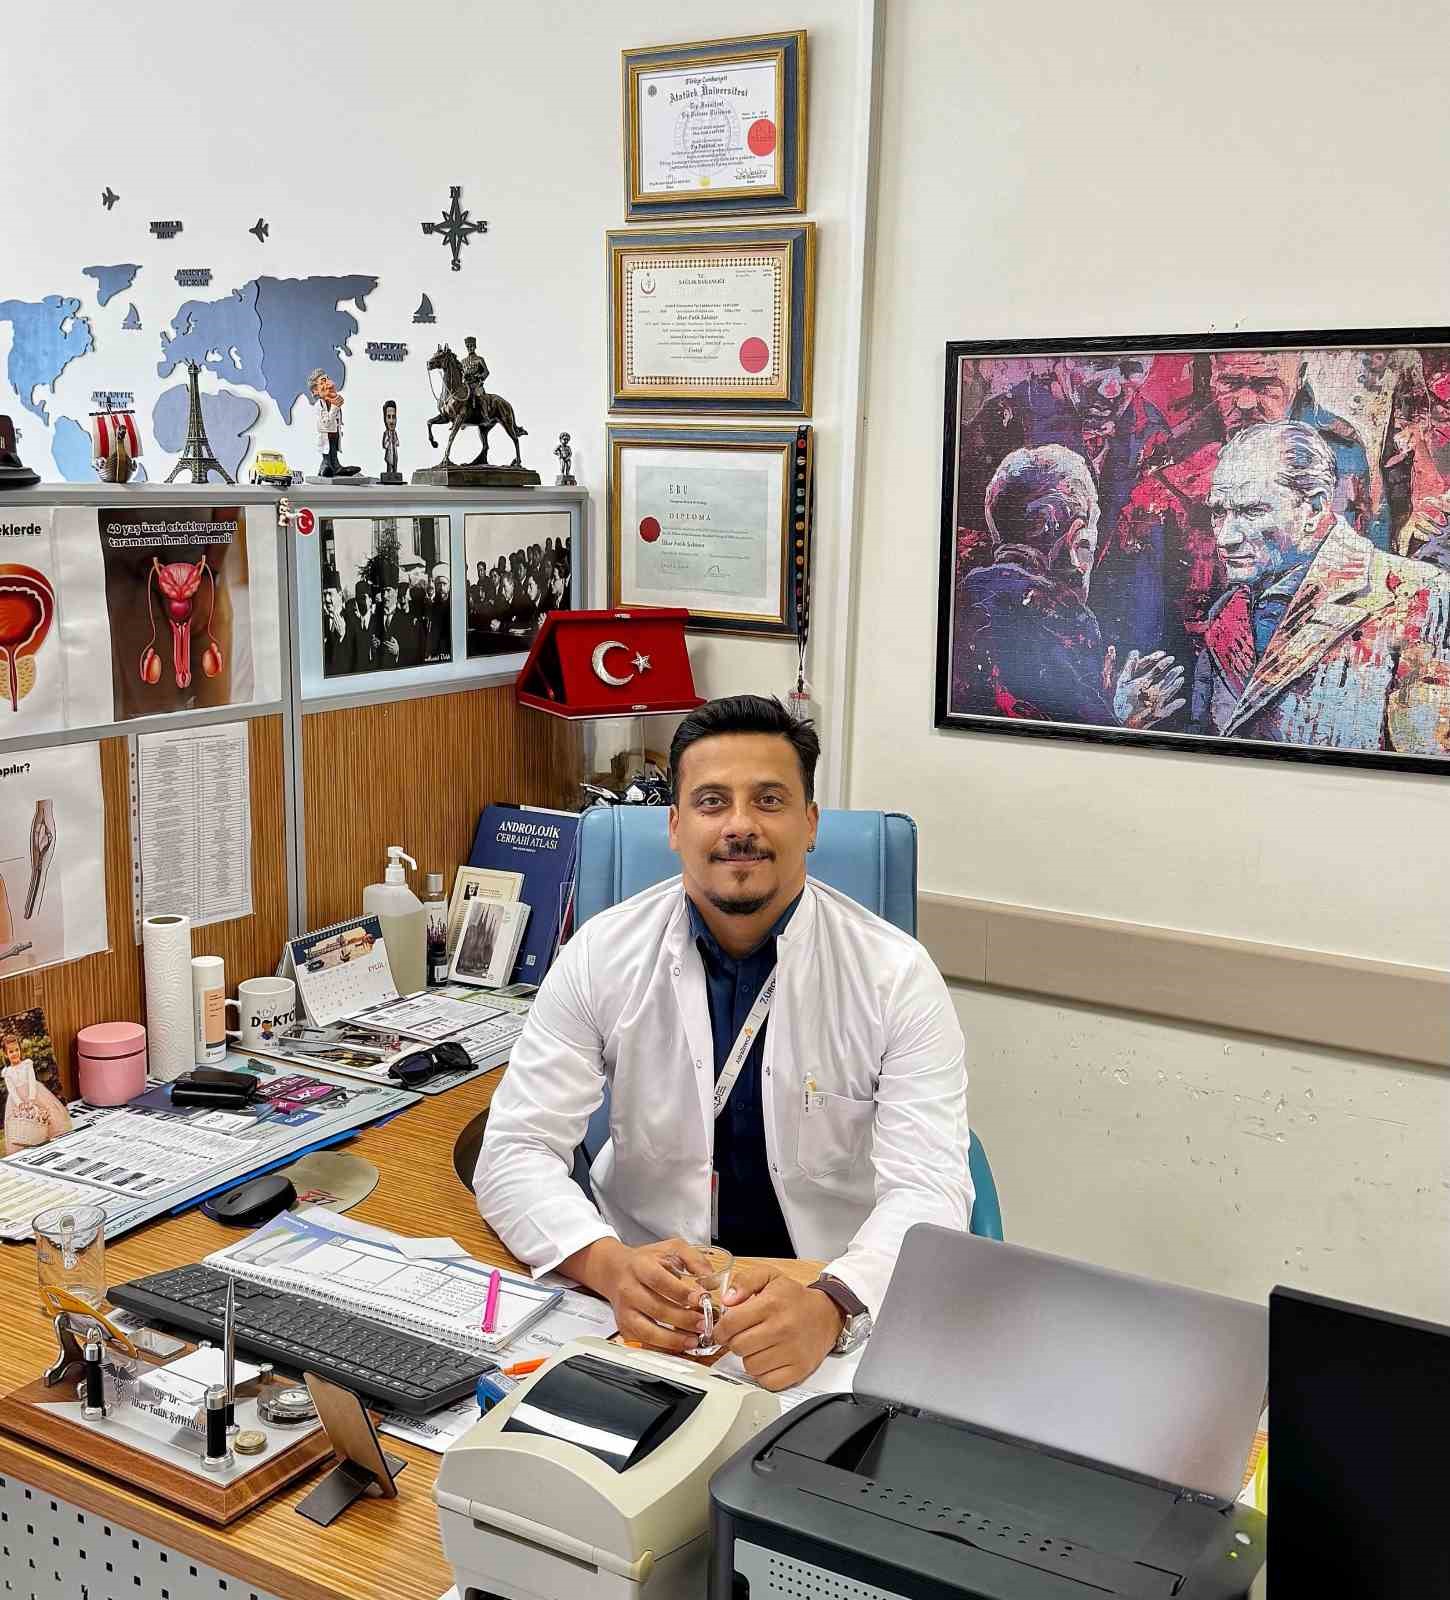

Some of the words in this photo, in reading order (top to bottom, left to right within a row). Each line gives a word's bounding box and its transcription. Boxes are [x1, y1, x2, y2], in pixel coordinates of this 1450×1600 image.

[449, 186, 461, 198] N
[420, 222, 434, 234] W
[451, 259, 461, 271] S
[107, 523, 121, 534] 40
[122, 524, 141, 536] yaş
[142, 521, 166, 533] üzeri
[167, 521, 205, 533] erkekler
[206, 520, 239, 533] prostat
[108, 536, 162, 547] taramasını
[163, 534, 189, 546] ihmal
[498, 821, 561, 839] ANDROLOJİK
[496, 833, 530, 846] CERRAHİ
[530, 837, 559, 850] ATLASI
